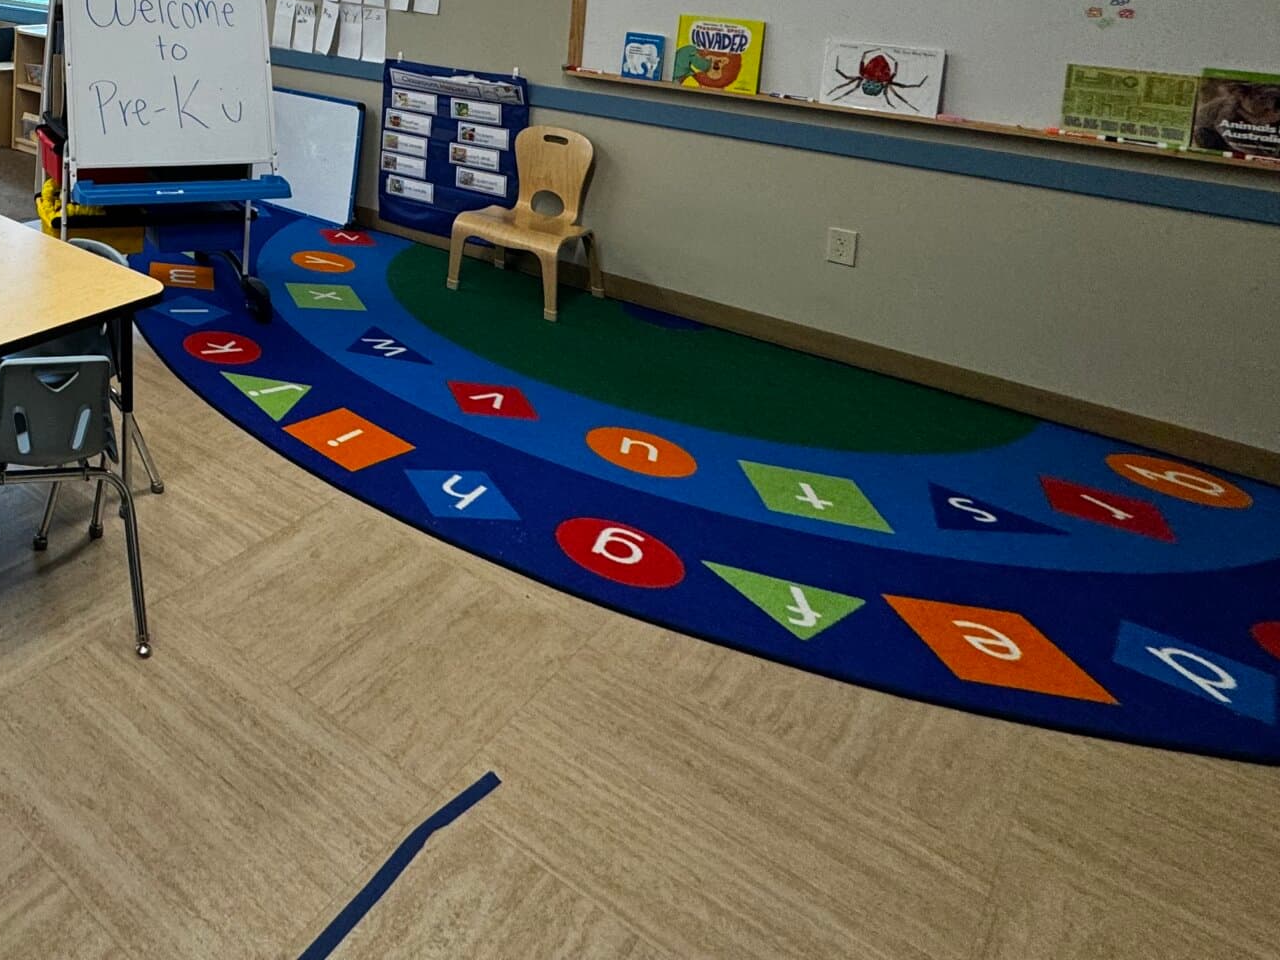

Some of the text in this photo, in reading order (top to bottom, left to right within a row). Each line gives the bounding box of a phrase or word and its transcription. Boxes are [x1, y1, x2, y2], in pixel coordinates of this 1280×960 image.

[155, 34, 189, 62] to
[691, 28, 748, 53] INVADER
[88, 74, 210, 136] Pre-K
[1220, 119, 1276, 133] Animals
[304, 254, 345, 268] y
[169, 268, 197, 285] m
[308, 289, 343, 302] x
[201, 340, 244, 355] k
[359, 336, 409, 358] w
[247, 381, 306, 398] j
[467, 391, 505, 411] v
[326, 428, 365, 449] i
[441, 473, 488, 511] h
[794, 481, 833, 511] t
[947, 496, 998, 523] s
[1079, 493, 1135, 521] r
[786, 584, 822, 628] f
[951, 619, 1023, 662] e
